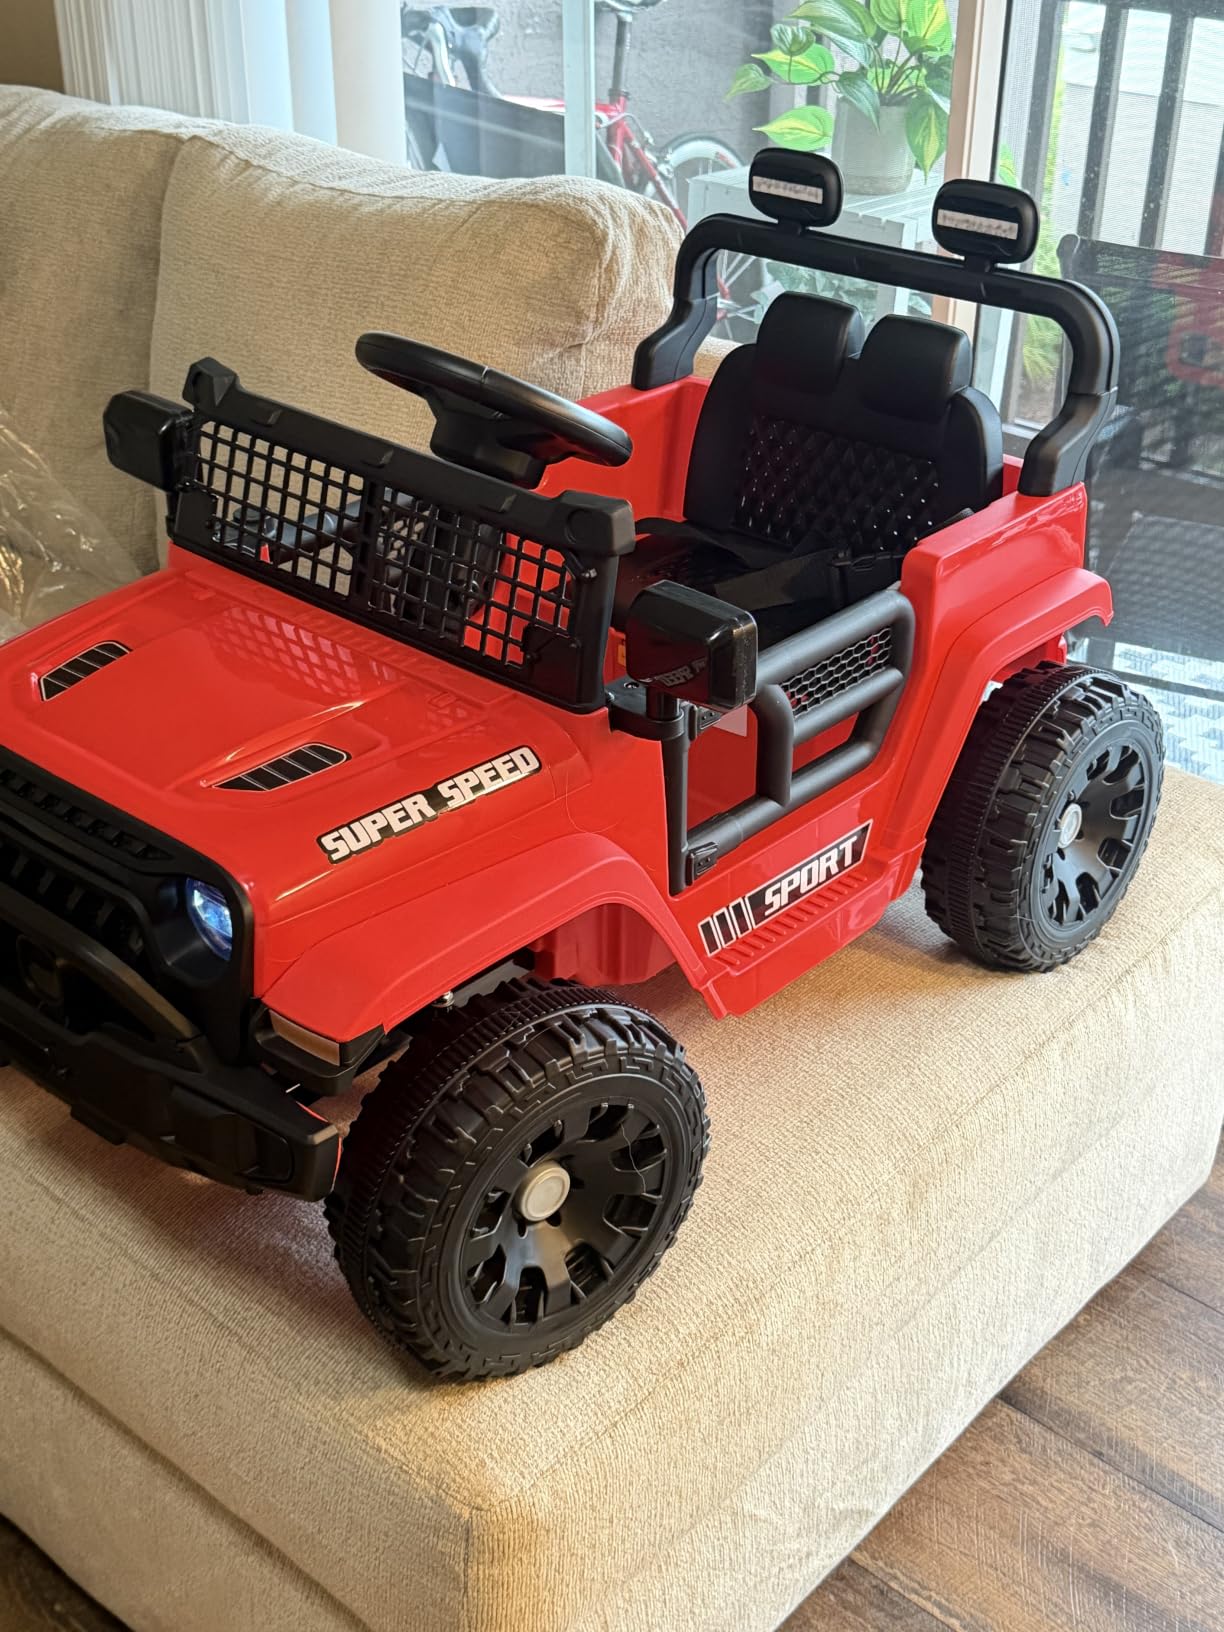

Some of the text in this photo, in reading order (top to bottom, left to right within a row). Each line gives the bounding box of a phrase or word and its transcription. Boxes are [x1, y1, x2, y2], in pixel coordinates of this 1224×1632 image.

[320, 746, 540, 861] SUPER SPEED
[764, 836, 857, 916] SPORT
